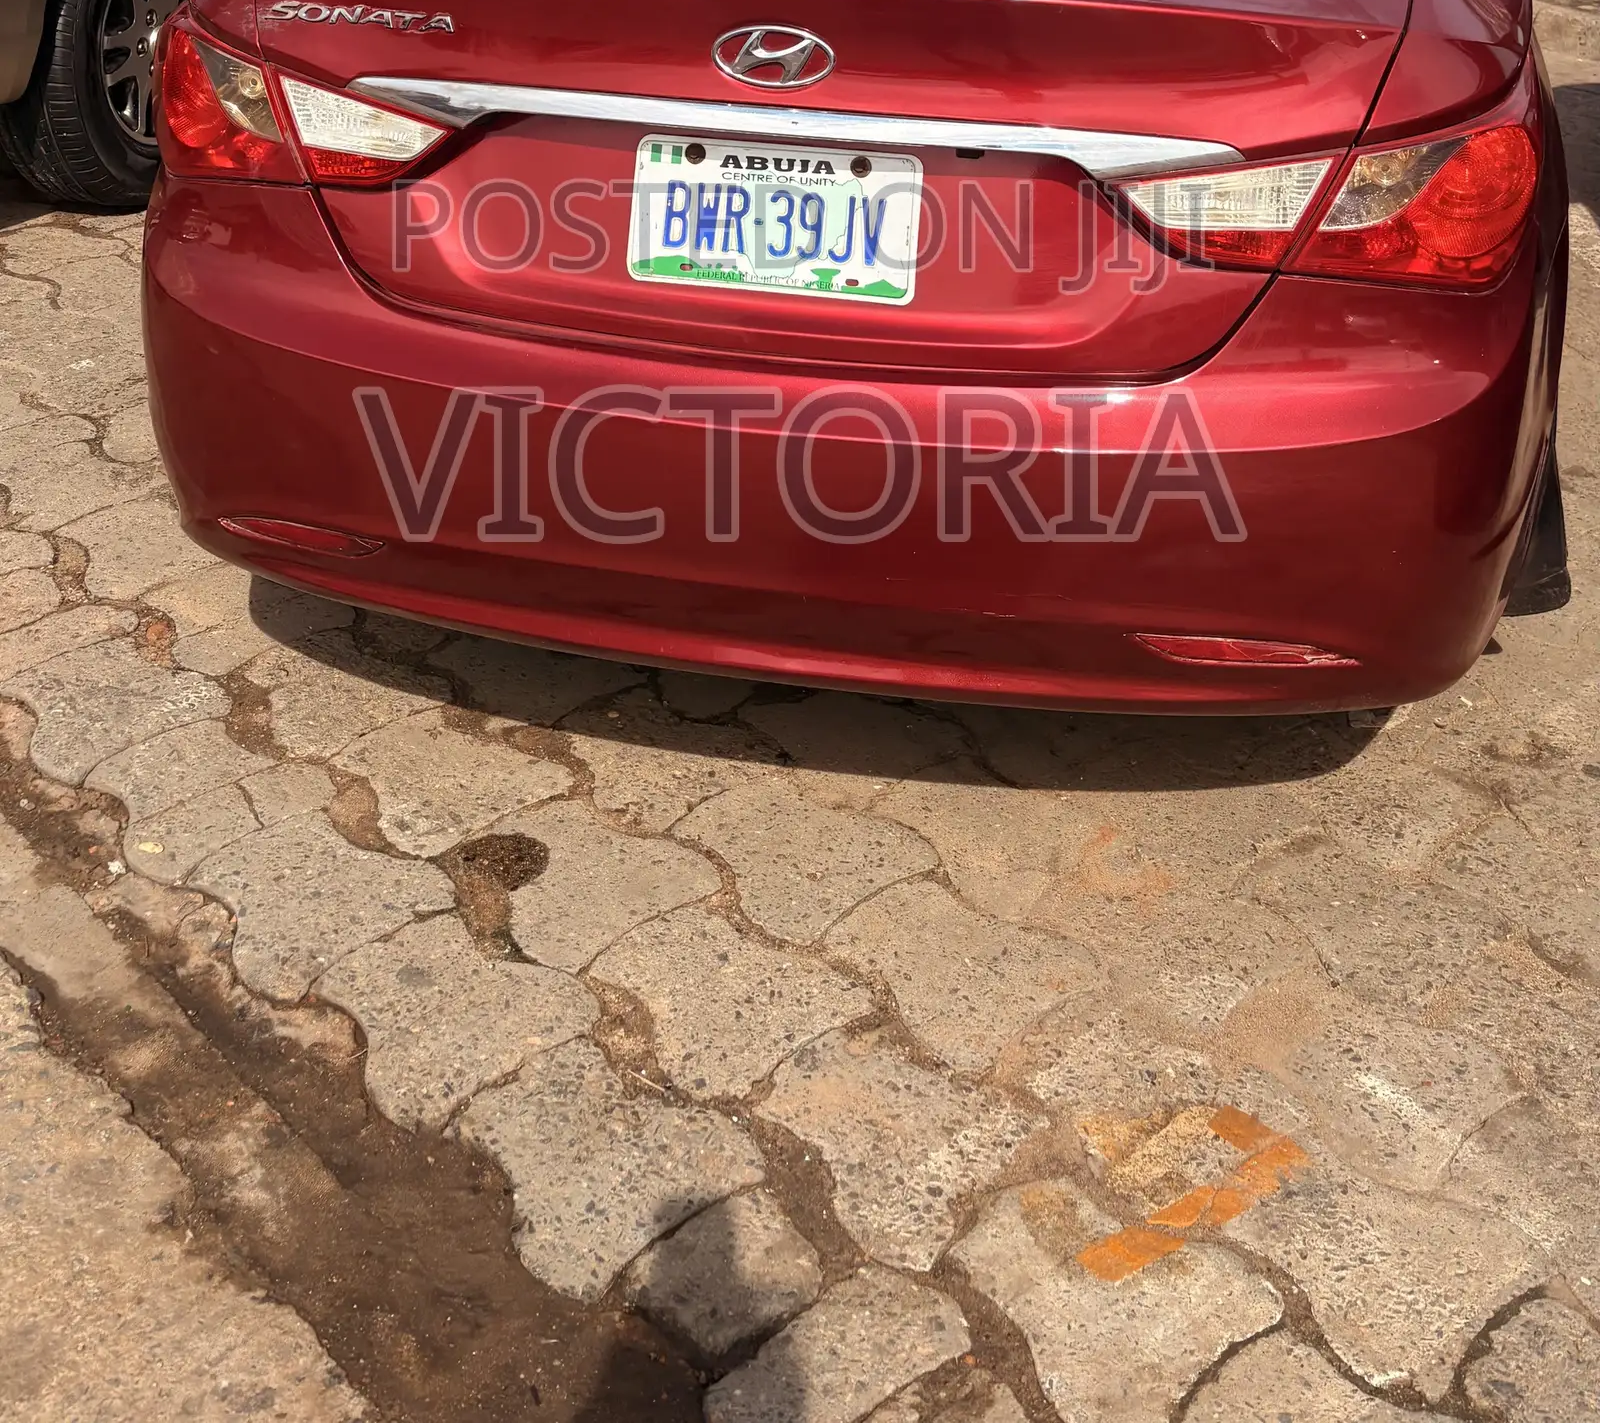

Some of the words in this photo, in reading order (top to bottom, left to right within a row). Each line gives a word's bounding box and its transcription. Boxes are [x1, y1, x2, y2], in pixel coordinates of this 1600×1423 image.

[264, 0, 455, 33] SONATA
[719, 154, 836, 175] ABUJA
[721, 171, 773, 183] CENTRE
[776, 175, 798, 184] OF
[799, 177, 837, 187] UNITY
[696, 269, 738, 281] FEDERAL
[801, 279, 840, 291] NIGERIA
